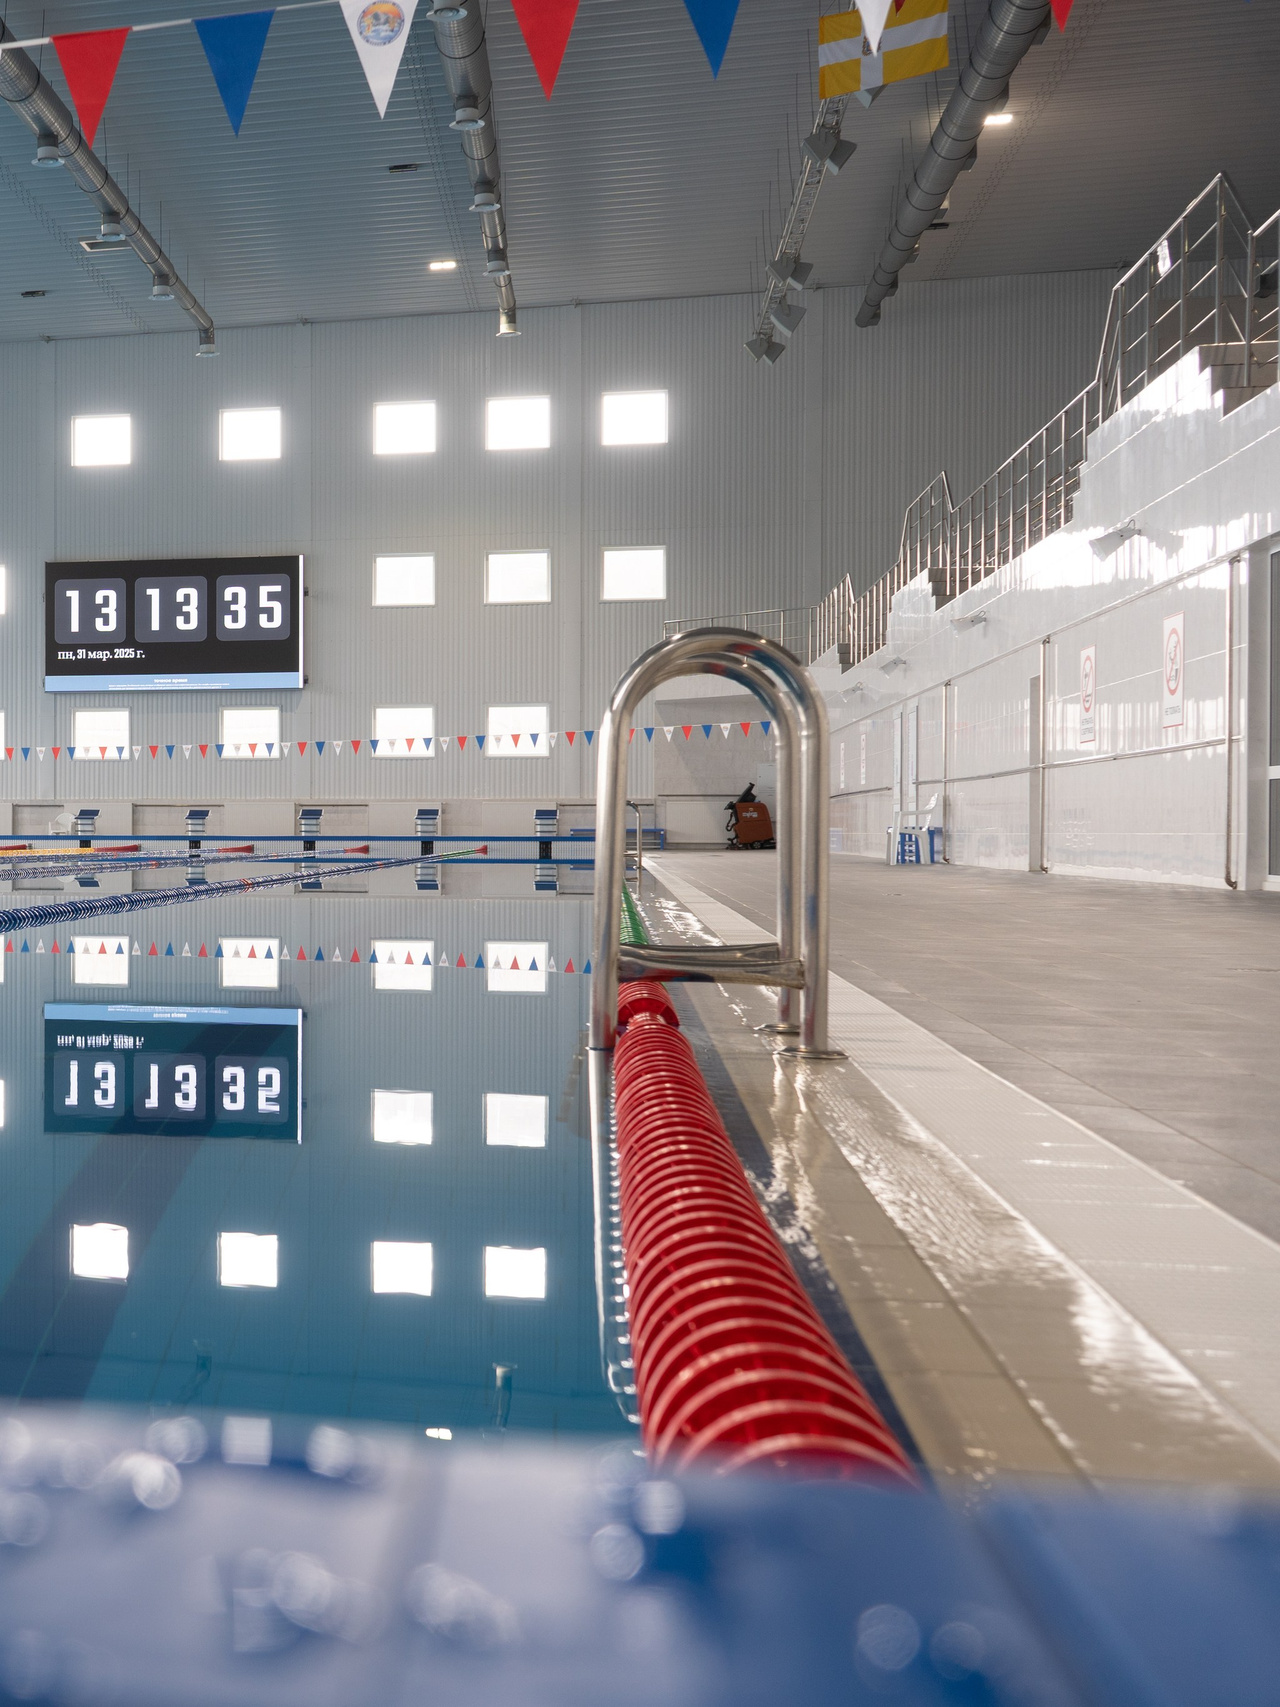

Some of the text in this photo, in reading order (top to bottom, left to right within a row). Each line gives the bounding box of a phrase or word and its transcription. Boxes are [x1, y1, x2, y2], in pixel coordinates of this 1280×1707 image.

[65, 584, 282, 632] 13 13 35
[57, 651, 76, 661] пн,
[76, 648, 87, 659] 31
[87, 650, 113, 662] мар.
[113, 647, 135, 659] 2025
